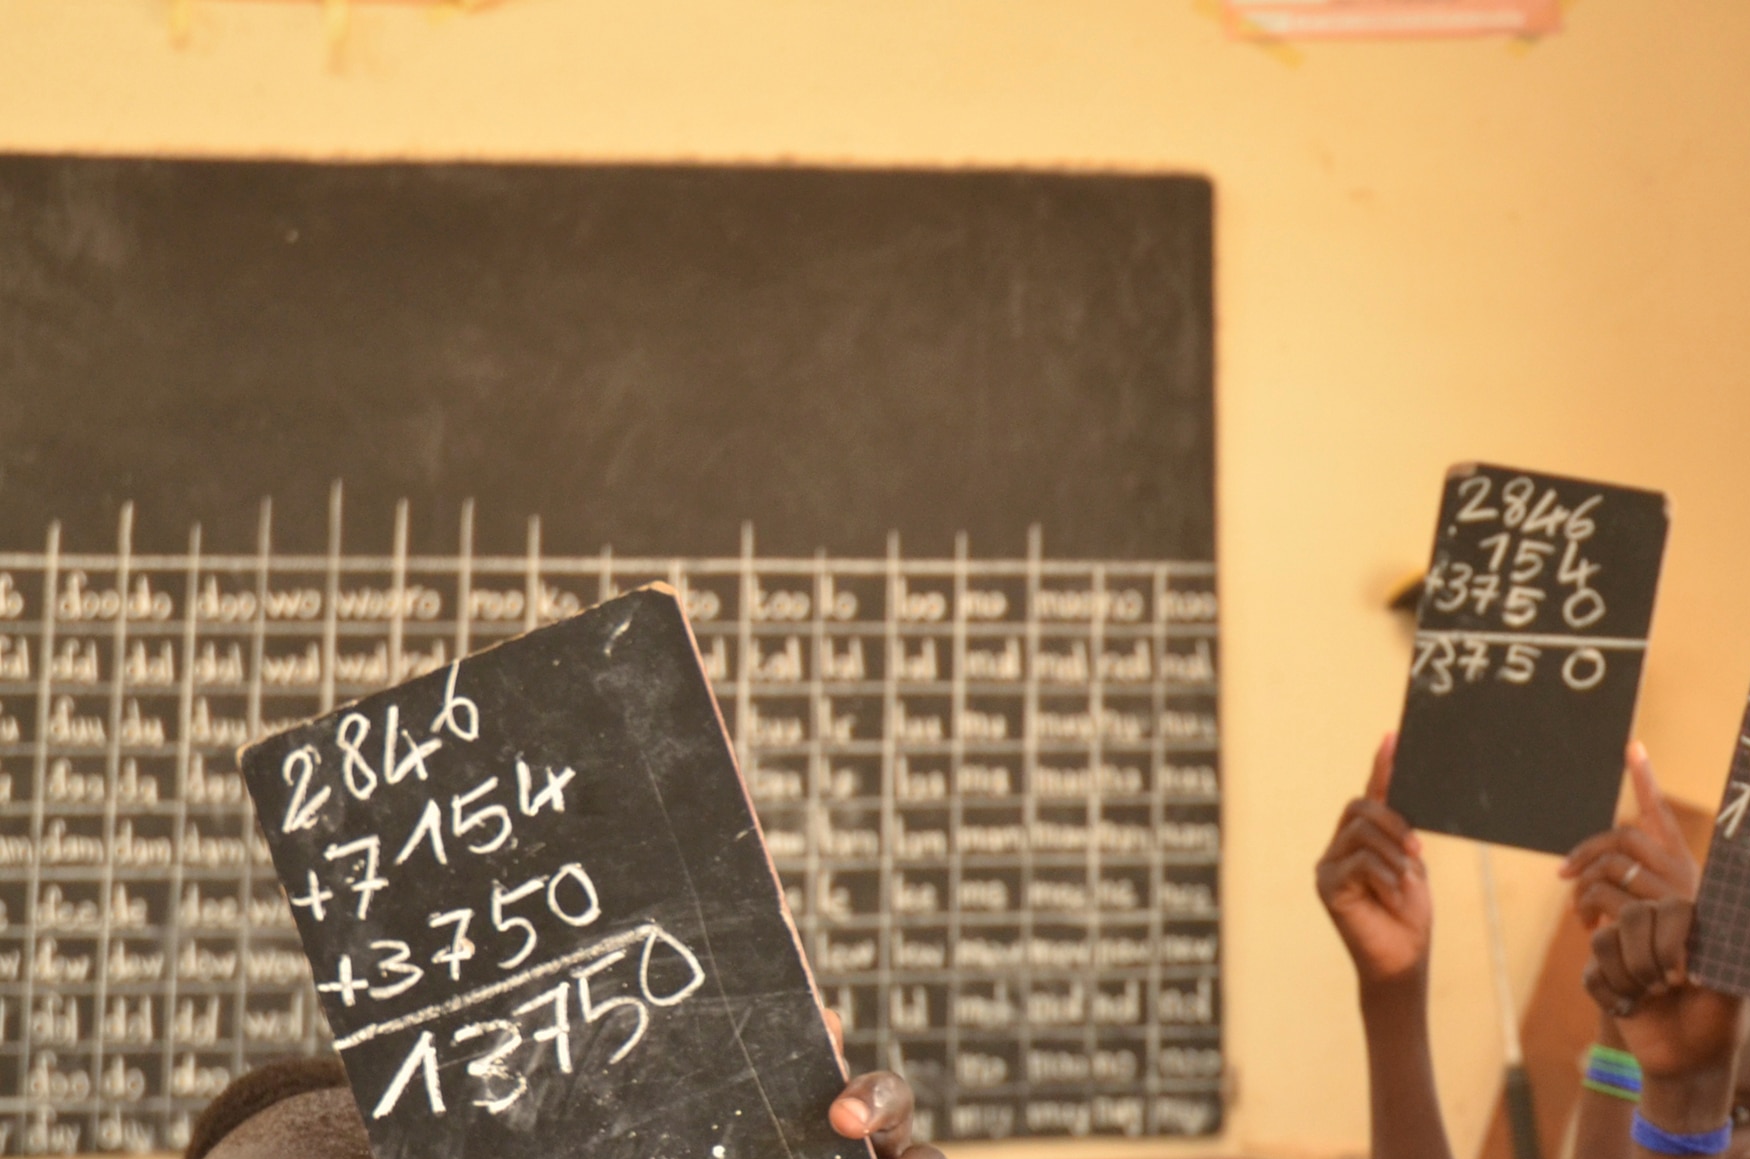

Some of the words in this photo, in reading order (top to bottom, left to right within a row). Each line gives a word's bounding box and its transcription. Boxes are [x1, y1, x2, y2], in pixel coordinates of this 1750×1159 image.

[1457, 476, 1604, 540] 2846
[282, 659, 479, 833] 2846
[373, 921, 706, 1119] 13750
